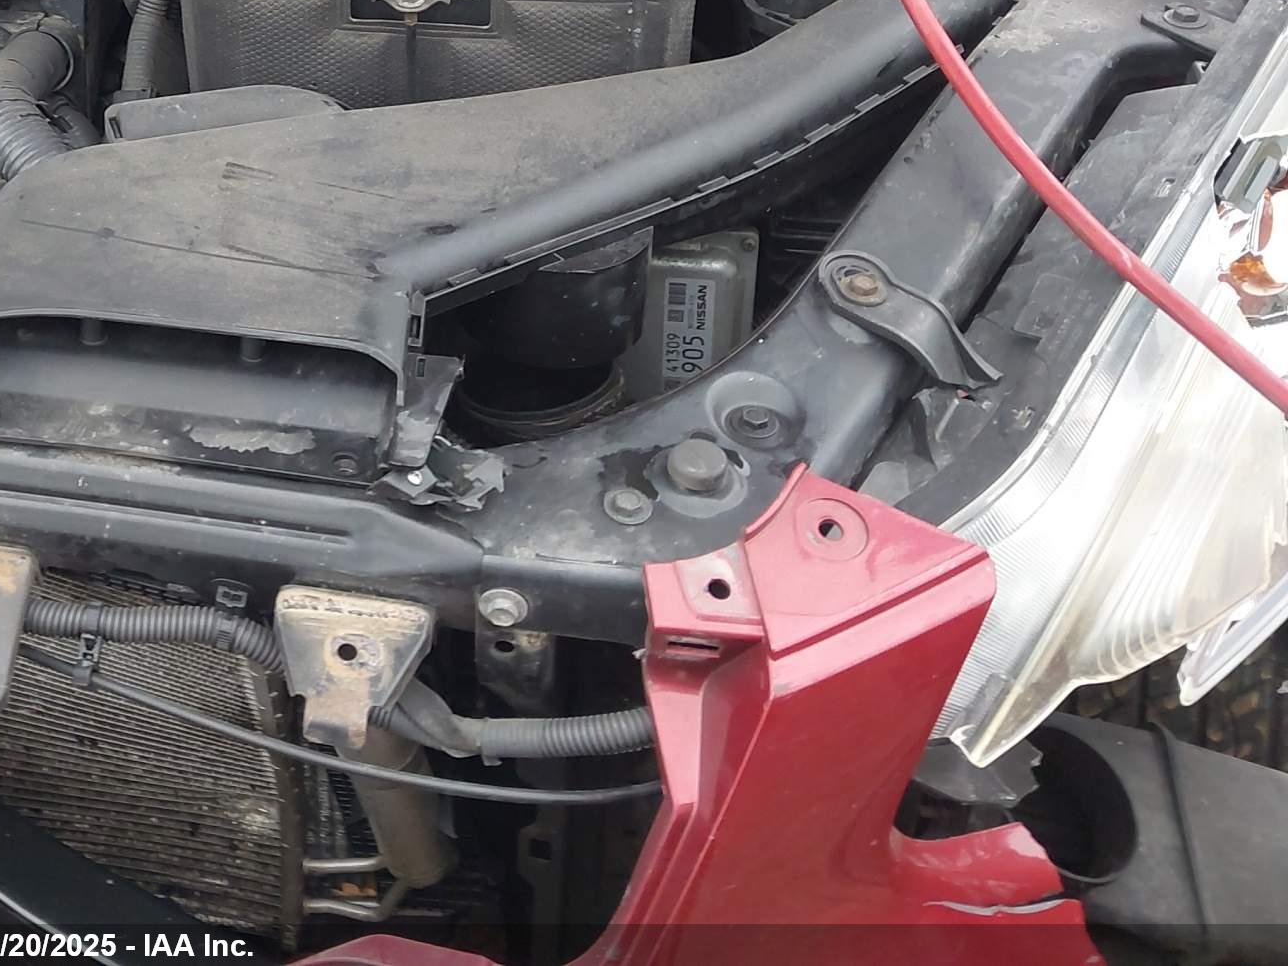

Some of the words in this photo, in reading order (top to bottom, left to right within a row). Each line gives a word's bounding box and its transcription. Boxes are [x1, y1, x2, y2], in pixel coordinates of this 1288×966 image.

[696, 284, 707, 330] NISSAN
[665, 333, 680, 372] 41309
[681, 335, 705, 373] 905
